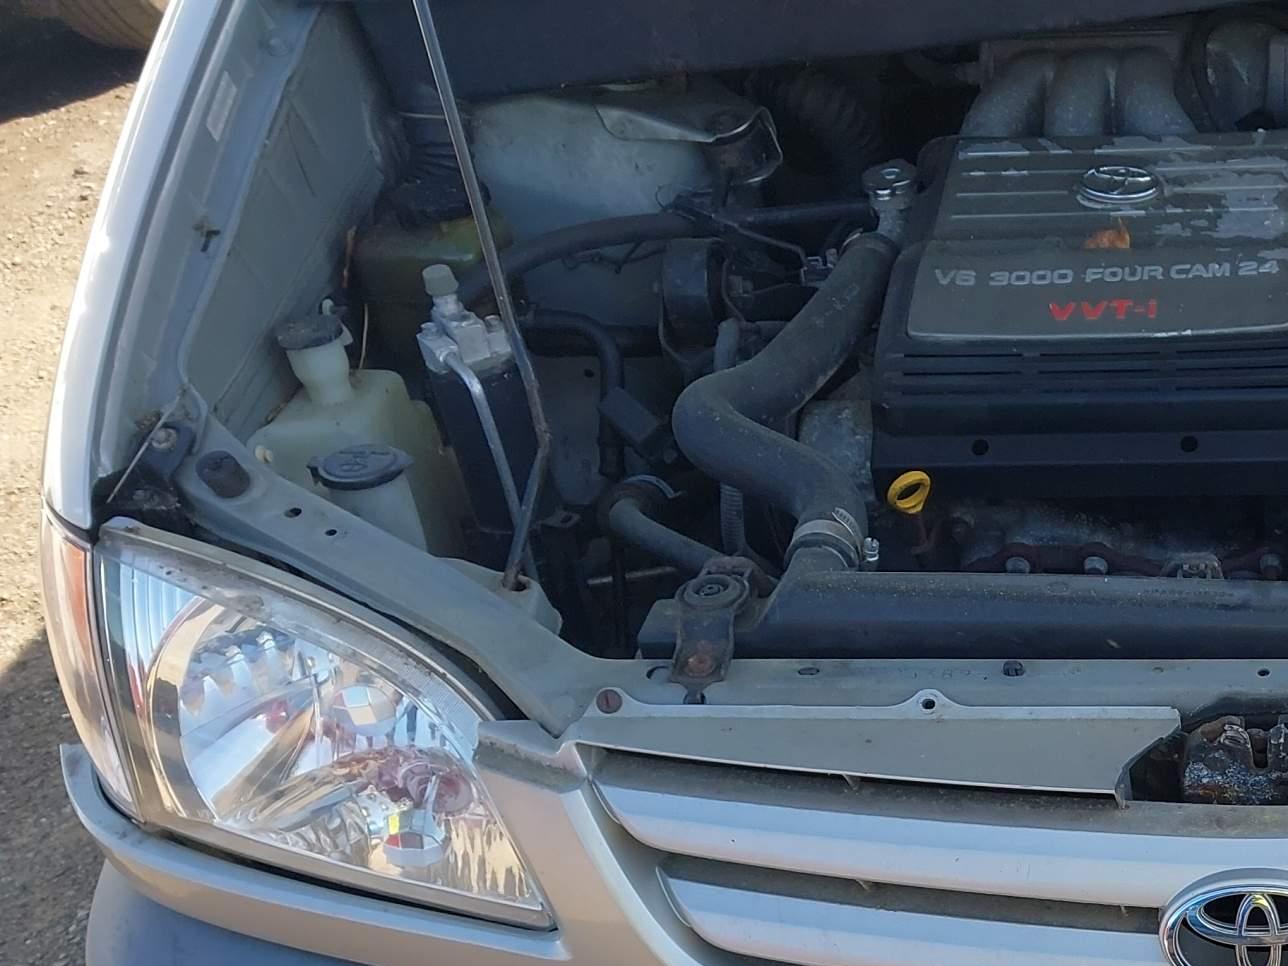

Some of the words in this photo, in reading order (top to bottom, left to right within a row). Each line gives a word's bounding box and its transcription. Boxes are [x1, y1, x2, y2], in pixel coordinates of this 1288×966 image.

[934, 268, 977, 286] V6
[988, 268, 1074, 286] 3000
[1084, 264, 1165, 283] FOUR
[1169, 261, 1231, 279] CAM
[1237, 259, 1280, 276] 24
